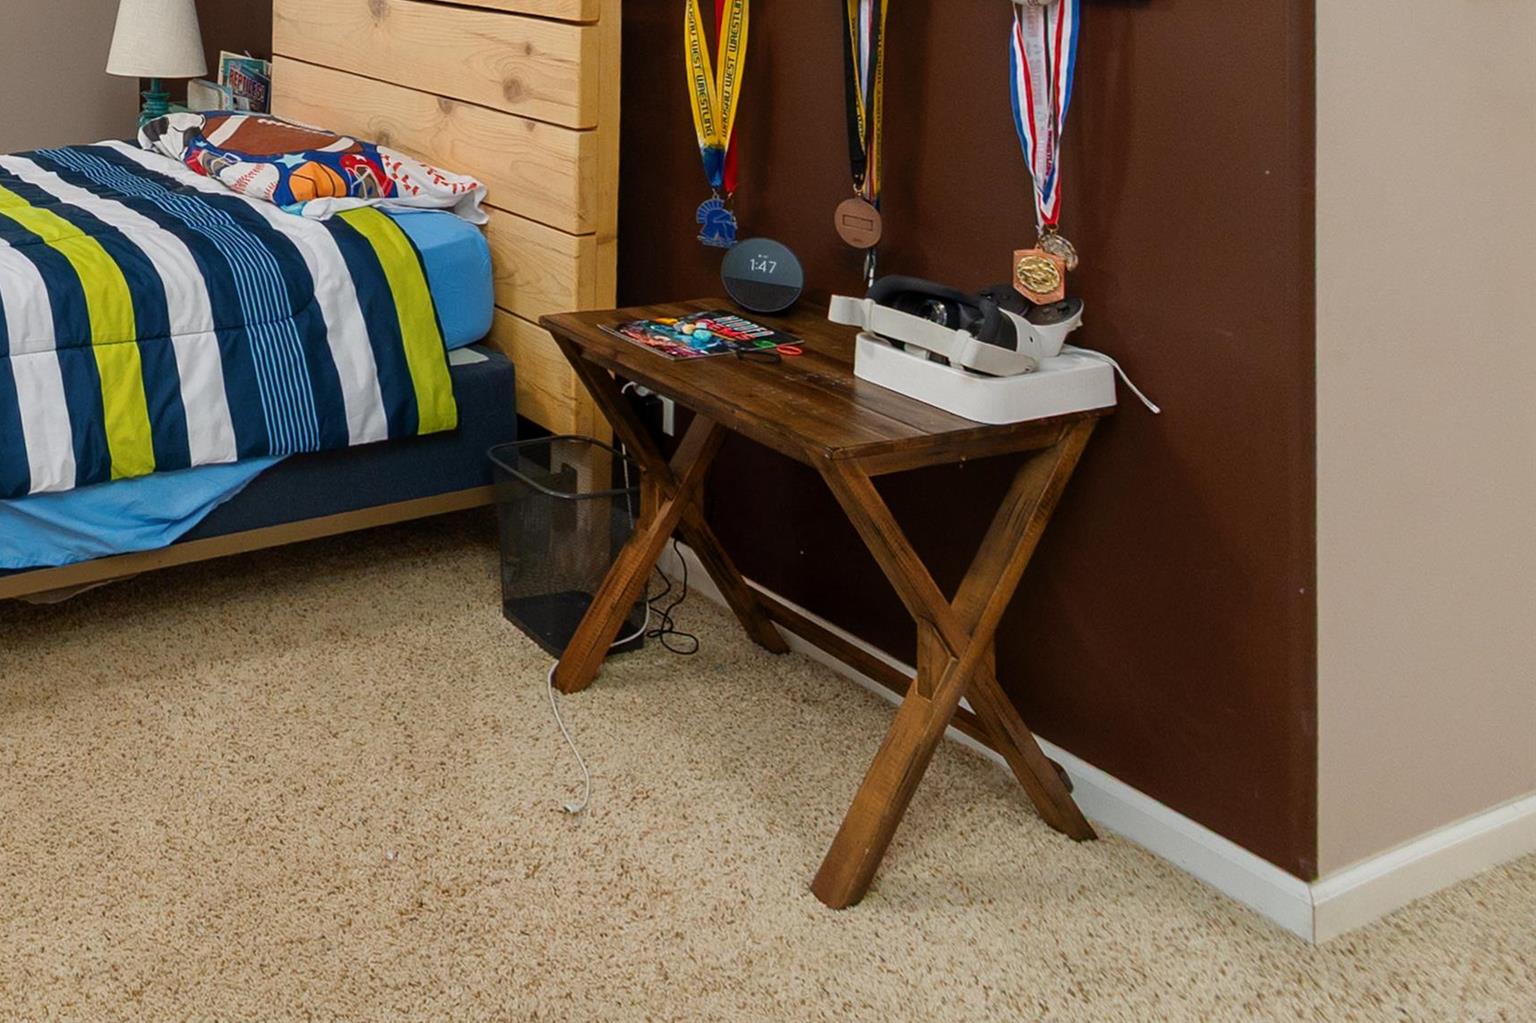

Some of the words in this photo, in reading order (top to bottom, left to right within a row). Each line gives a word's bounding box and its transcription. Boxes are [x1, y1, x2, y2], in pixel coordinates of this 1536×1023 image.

[691, 39, 702, 69] WEST
[725, 57, 736, 87] WEST
[750, 258, 777, 274] 1:47
